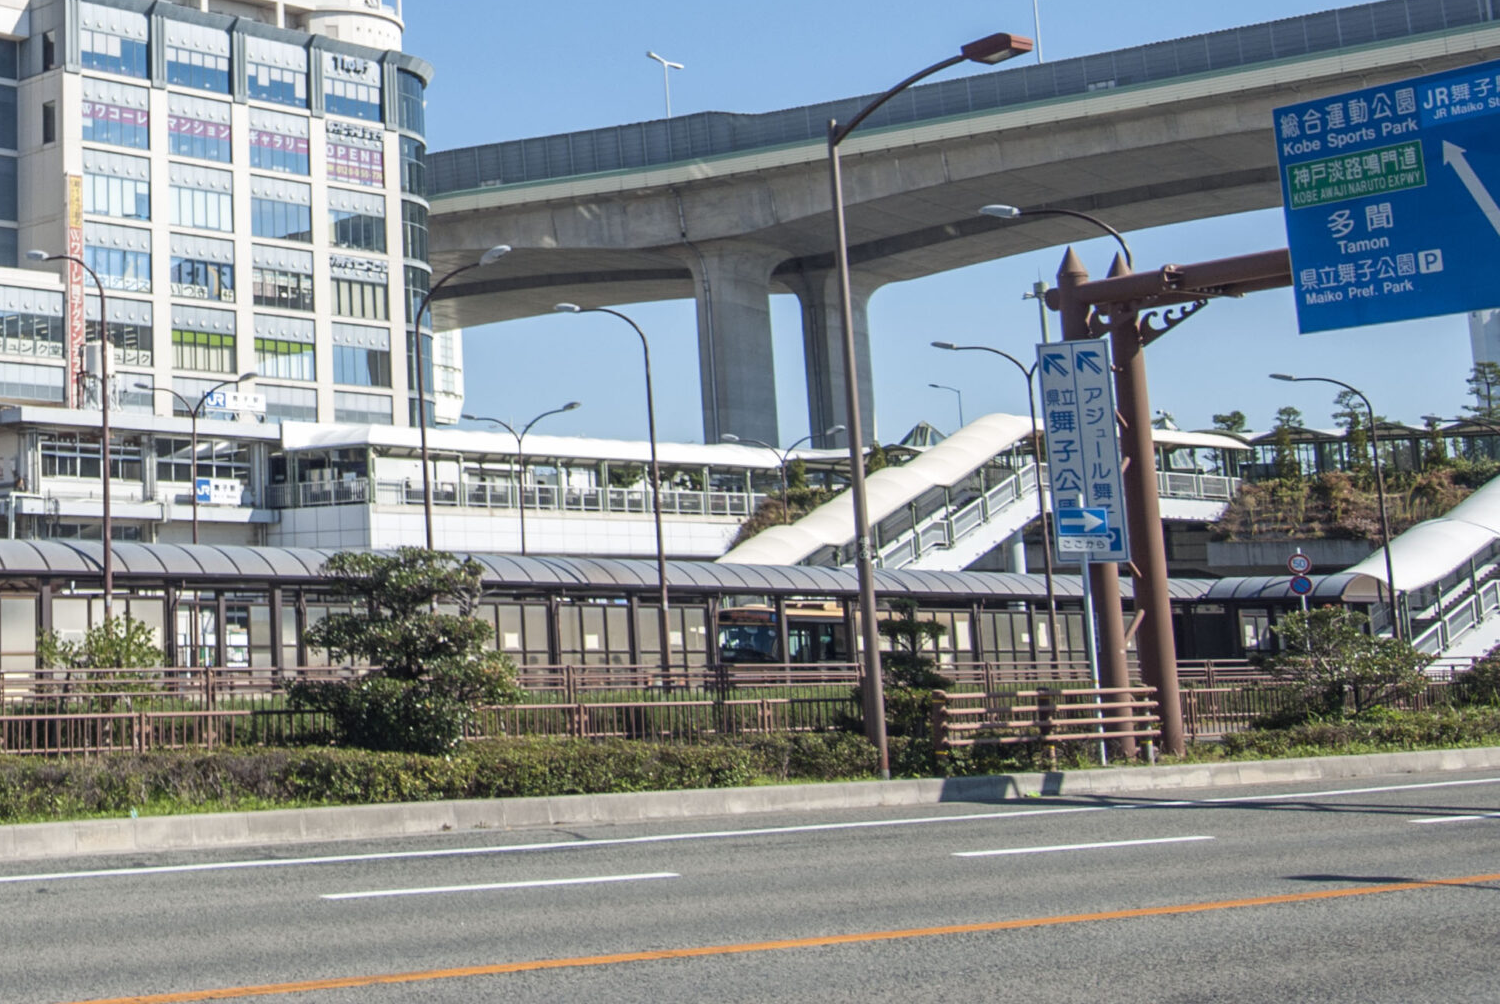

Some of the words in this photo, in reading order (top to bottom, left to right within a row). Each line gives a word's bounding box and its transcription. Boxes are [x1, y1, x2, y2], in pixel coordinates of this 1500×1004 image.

[1423, 75, 1500, 109] JR舞子
[1280, 87, 1416, 139] 総合運動公園
[1433, 107, 1448, 120] JR
[1450, 102, 1484, 116] Maiko
[168, 118, 230, 139] マンション
[249, 130, 308, 150] ギャラリー
[1283, 137, 1322, 156] Kobe
[1327, 126, 1376, 149] Sports
[1382, 118, 1418, 138] Park
[1293, 146, 1418, 189] 神戸淡路鳴門道
[1293, 188, 1319, 205] KOBE
[1320, 182, 1348, 199] AWAJI
[1349, 177, 1387, 195] NARUTO
[1387, 170, 1421, 188] EXPWY
[1327, 202, 1394, 238] 多聞
[1337, 237, 1390, 254] Tamon
[1300, 253, 1416, 291] 県立舞子公園
[1306, 290, 1343, 305] Maiko
[1348, 284, 1379, 299] Pref.
[1384, 278, 1414, 294] Park
[207, 392, 225, 407] JR
[196, 484, 210, 496] JR
[1062, 539, 1106, 549] ここから
[1292, 558, 1307, 569] 50
